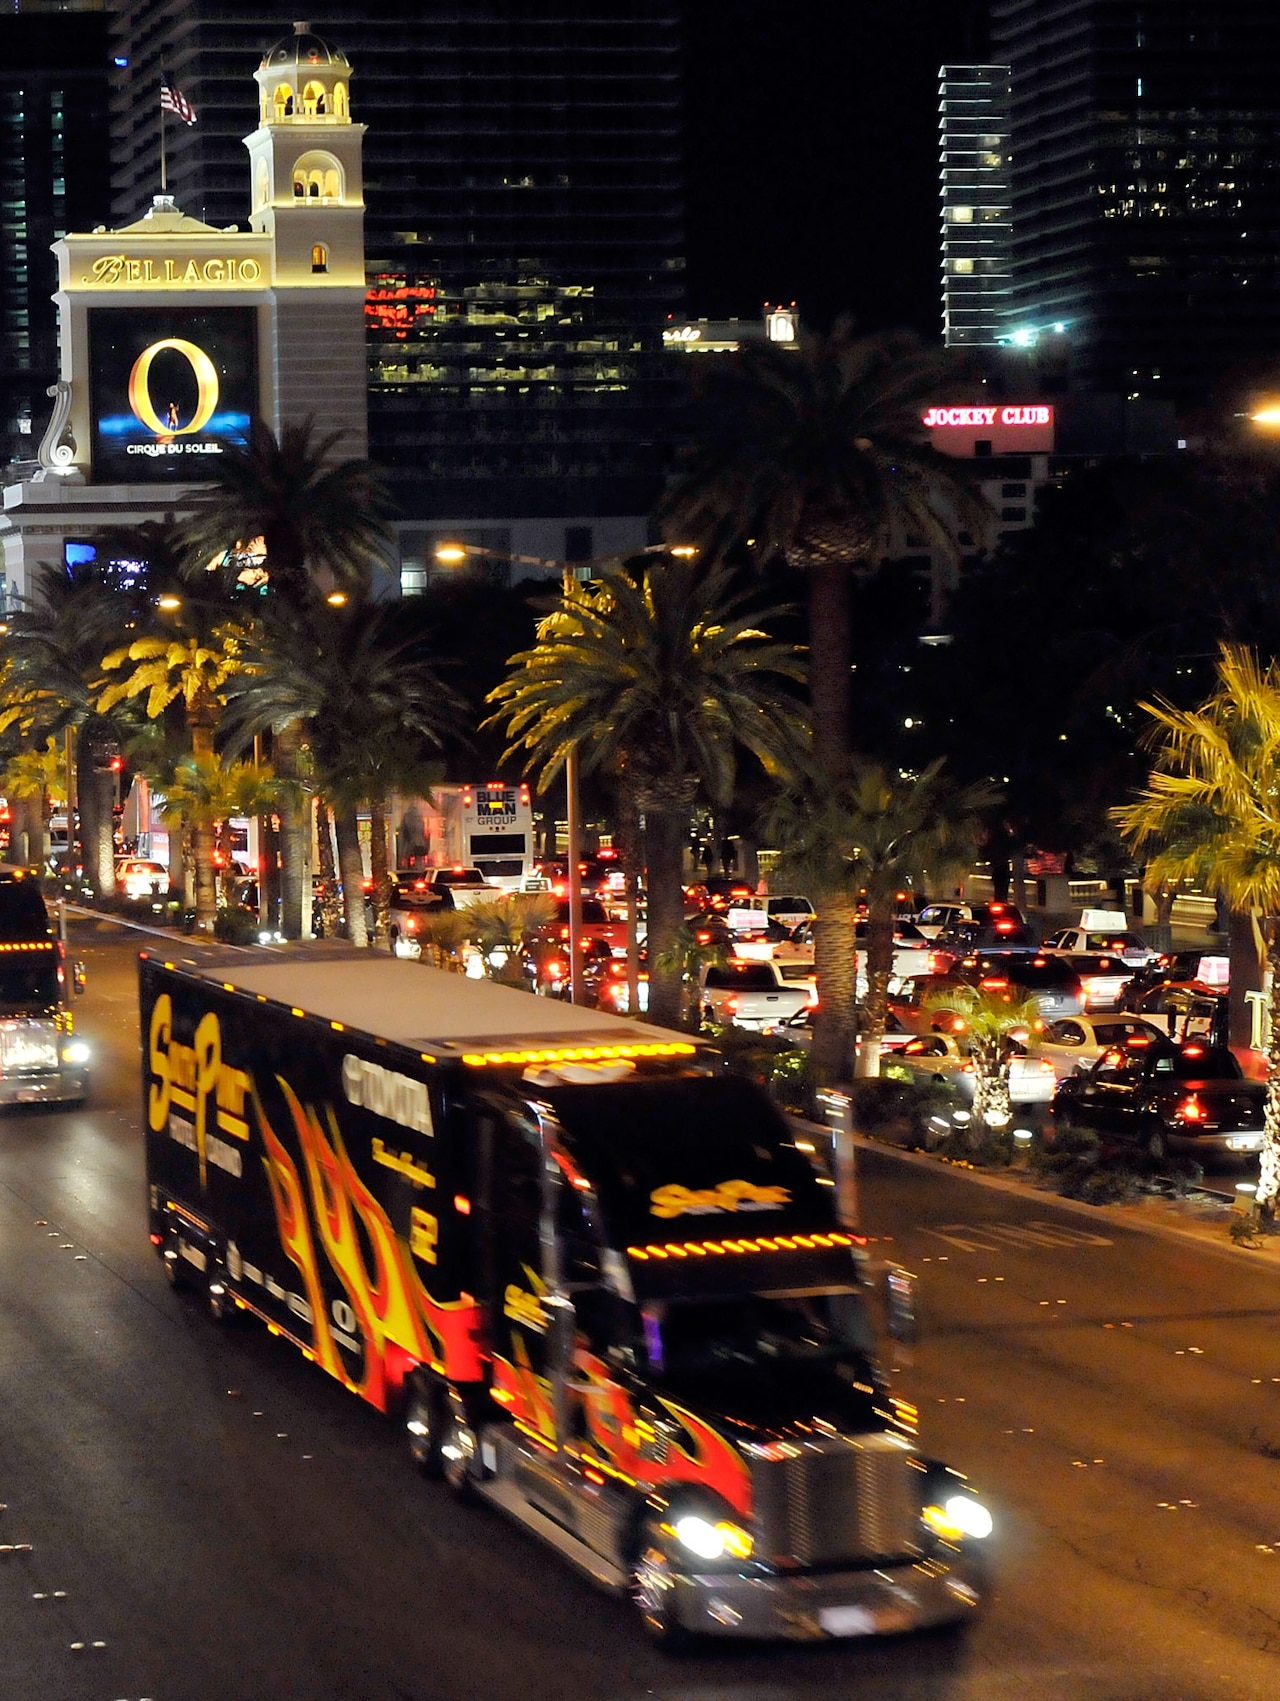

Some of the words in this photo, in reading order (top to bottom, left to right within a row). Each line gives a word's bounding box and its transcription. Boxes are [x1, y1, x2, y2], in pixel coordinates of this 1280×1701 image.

[82, 254, 262, 286] BELLAGIO
[128, 338, 220, 436] O
[924, 408, 998, 427] JOCKEY
[1001, 406, 1050, 425] CLUB
[127, 444, 166, 457] CIRQUE
[167, 444, 183, 454] DU
[185, 444, 223, 454] SOLEIL
[476, 791, 516, 802] BLUE
[477, 802, 516, 816] MAN
[477, 816, 517, 825] GROUP
